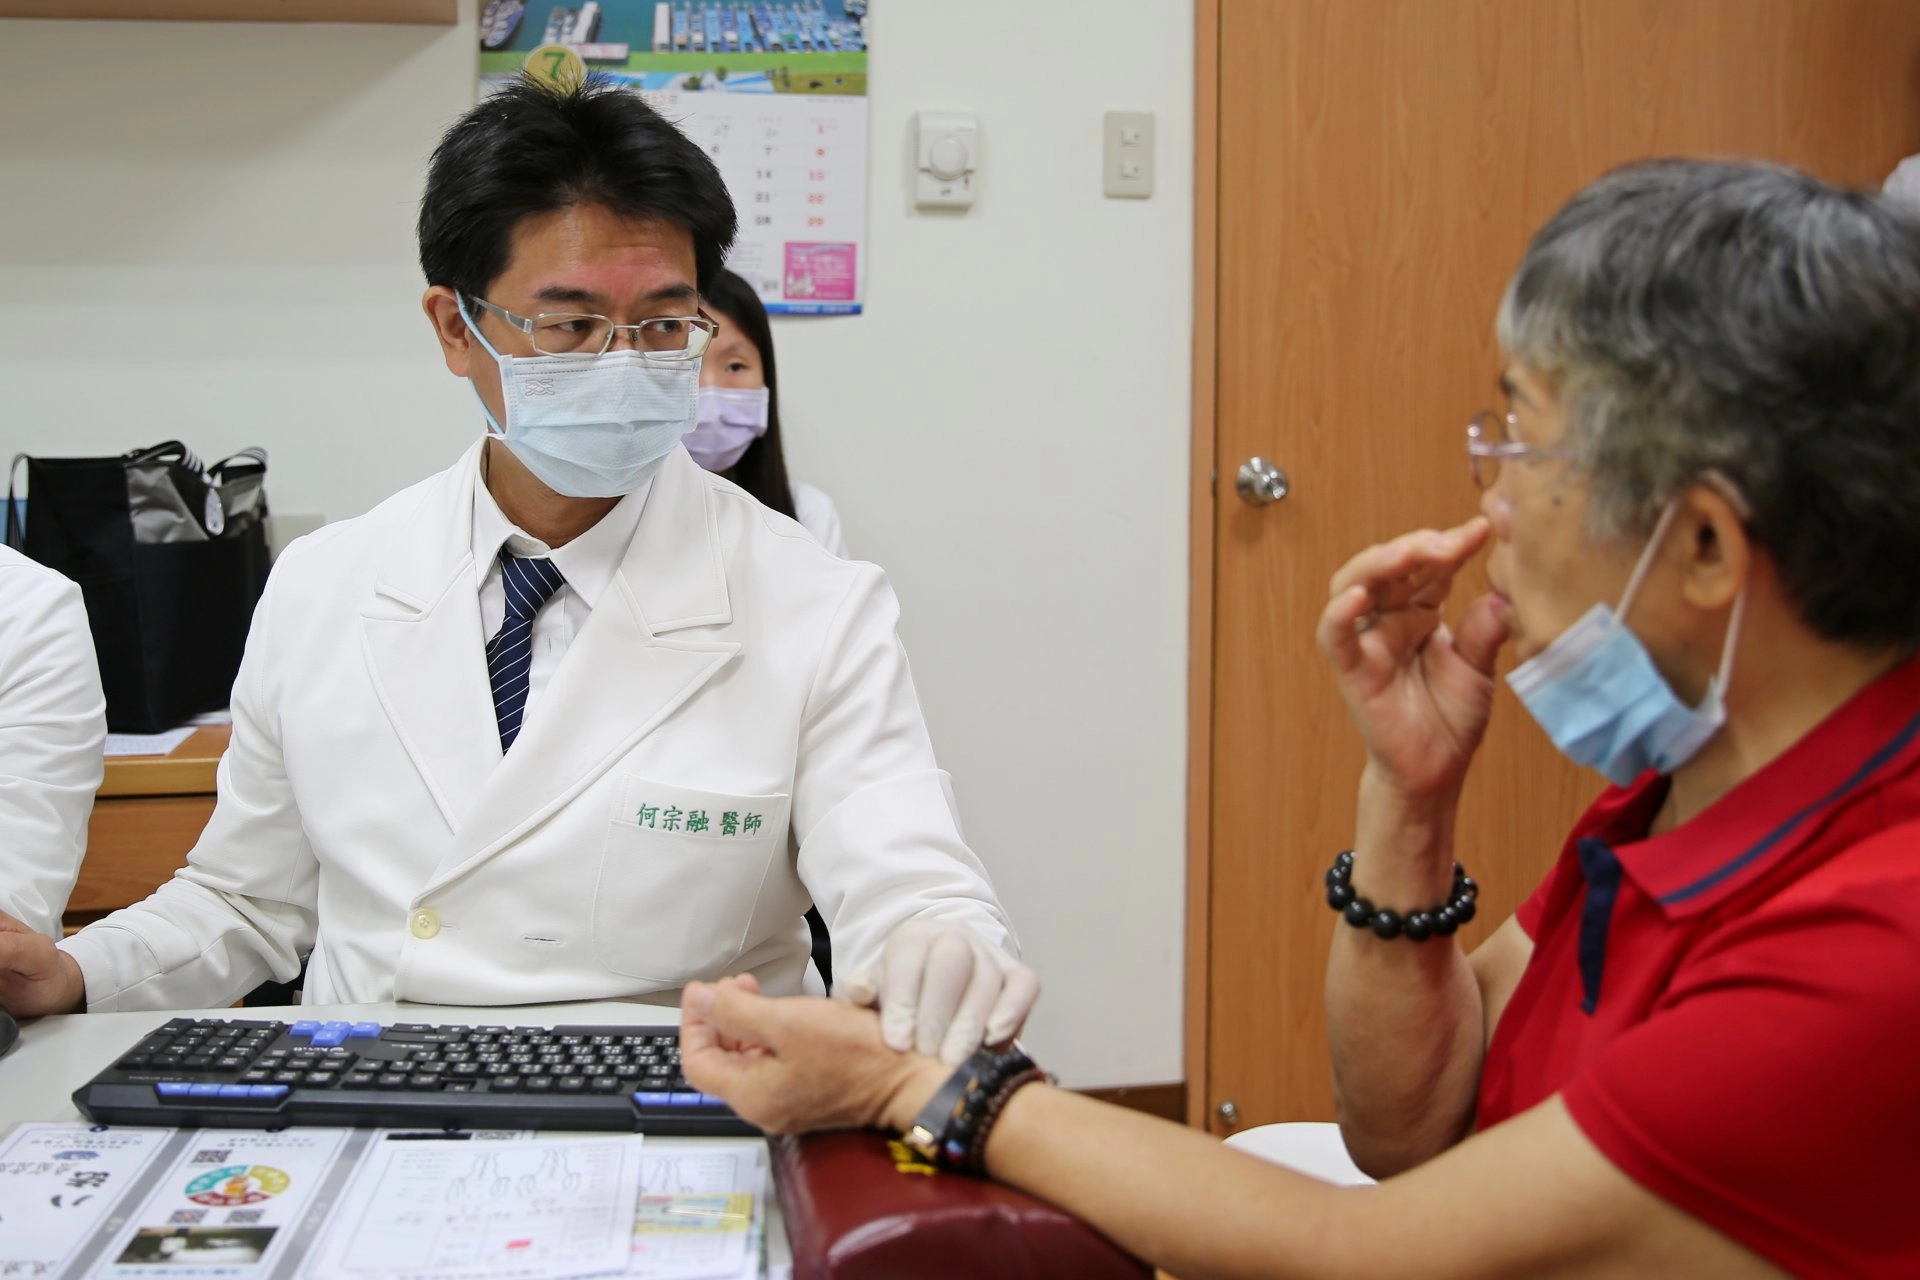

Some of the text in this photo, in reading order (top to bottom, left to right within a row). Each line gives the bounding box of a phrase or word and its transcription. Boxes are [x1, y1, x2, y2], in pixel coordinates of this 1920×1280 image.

[543, 51, 566, 80] 7
[636, 803, 763, 836] 何宗融 醫師
